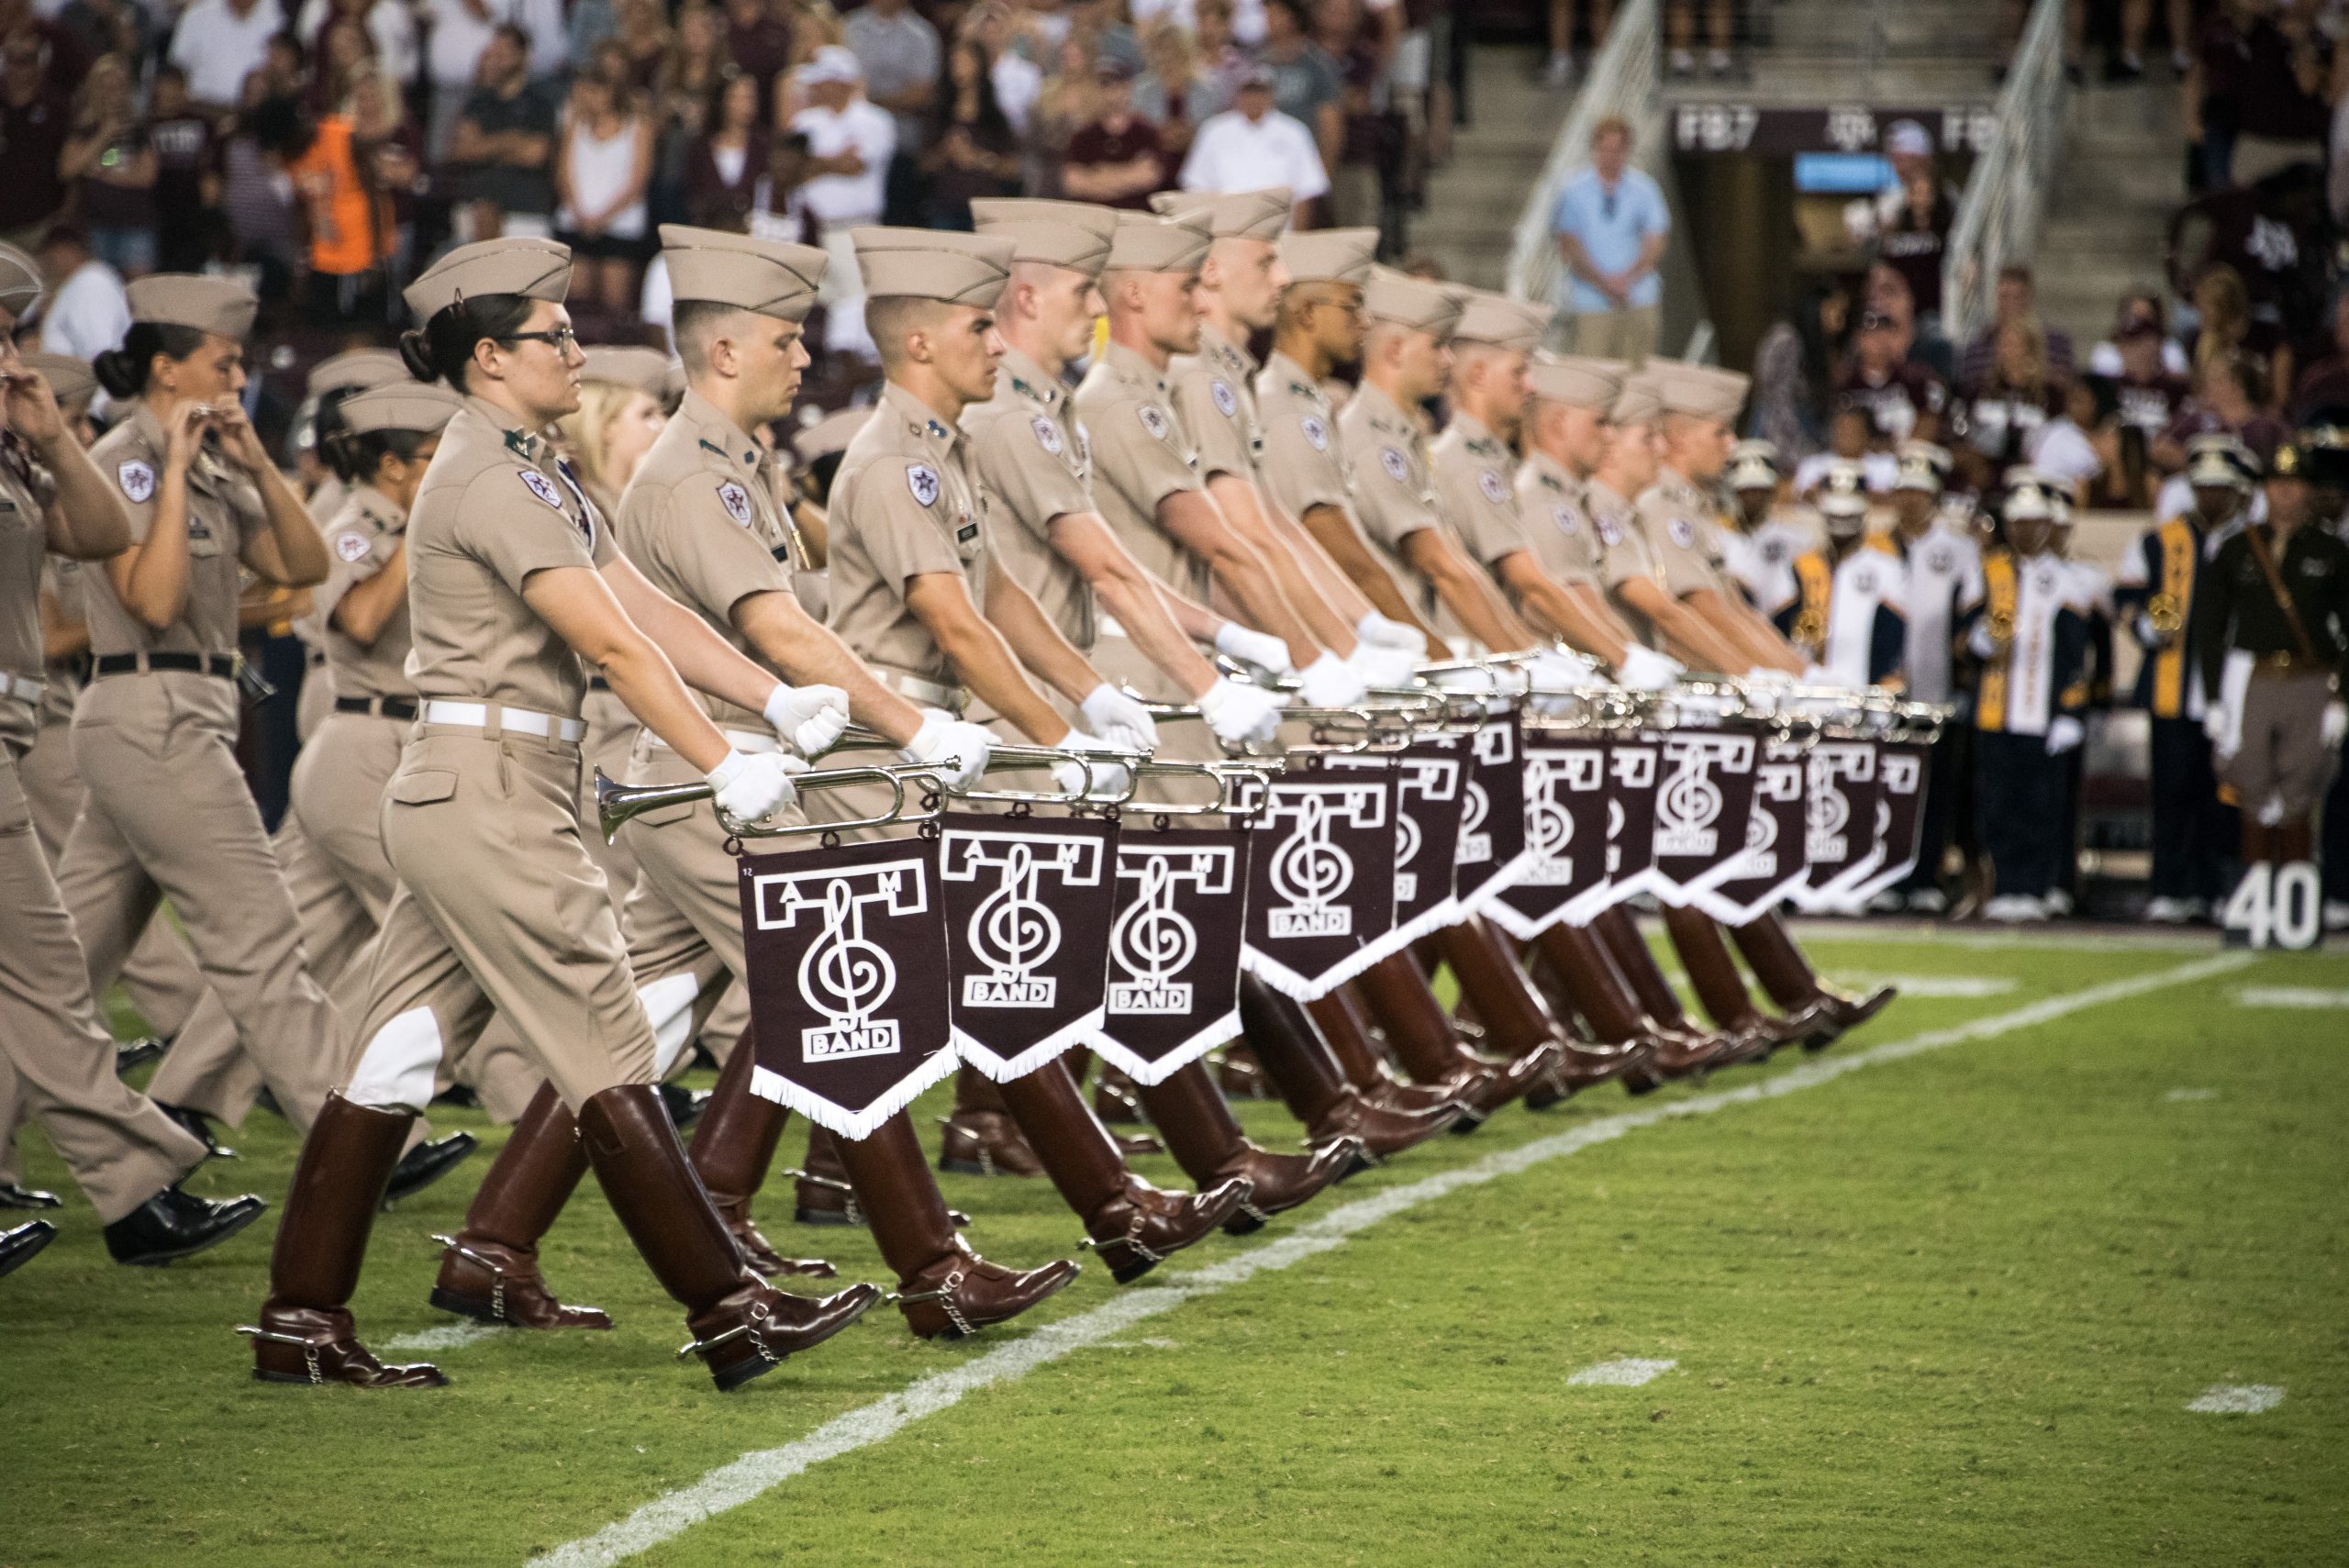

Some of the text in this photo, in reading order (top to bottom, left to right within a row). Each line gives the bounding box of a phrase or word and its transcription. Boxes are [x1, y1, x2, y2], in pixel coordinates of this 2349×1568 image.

[742, 867, 753, 876] 12
[2225, 861, 2320, 949] 40
[1276, 914, 1345, 933] BAND
[973, 981, 1048, 1002] BAND
[1117, 989, 1186, 1009] BAND
[811, 1027, 891, 1055] BAND
